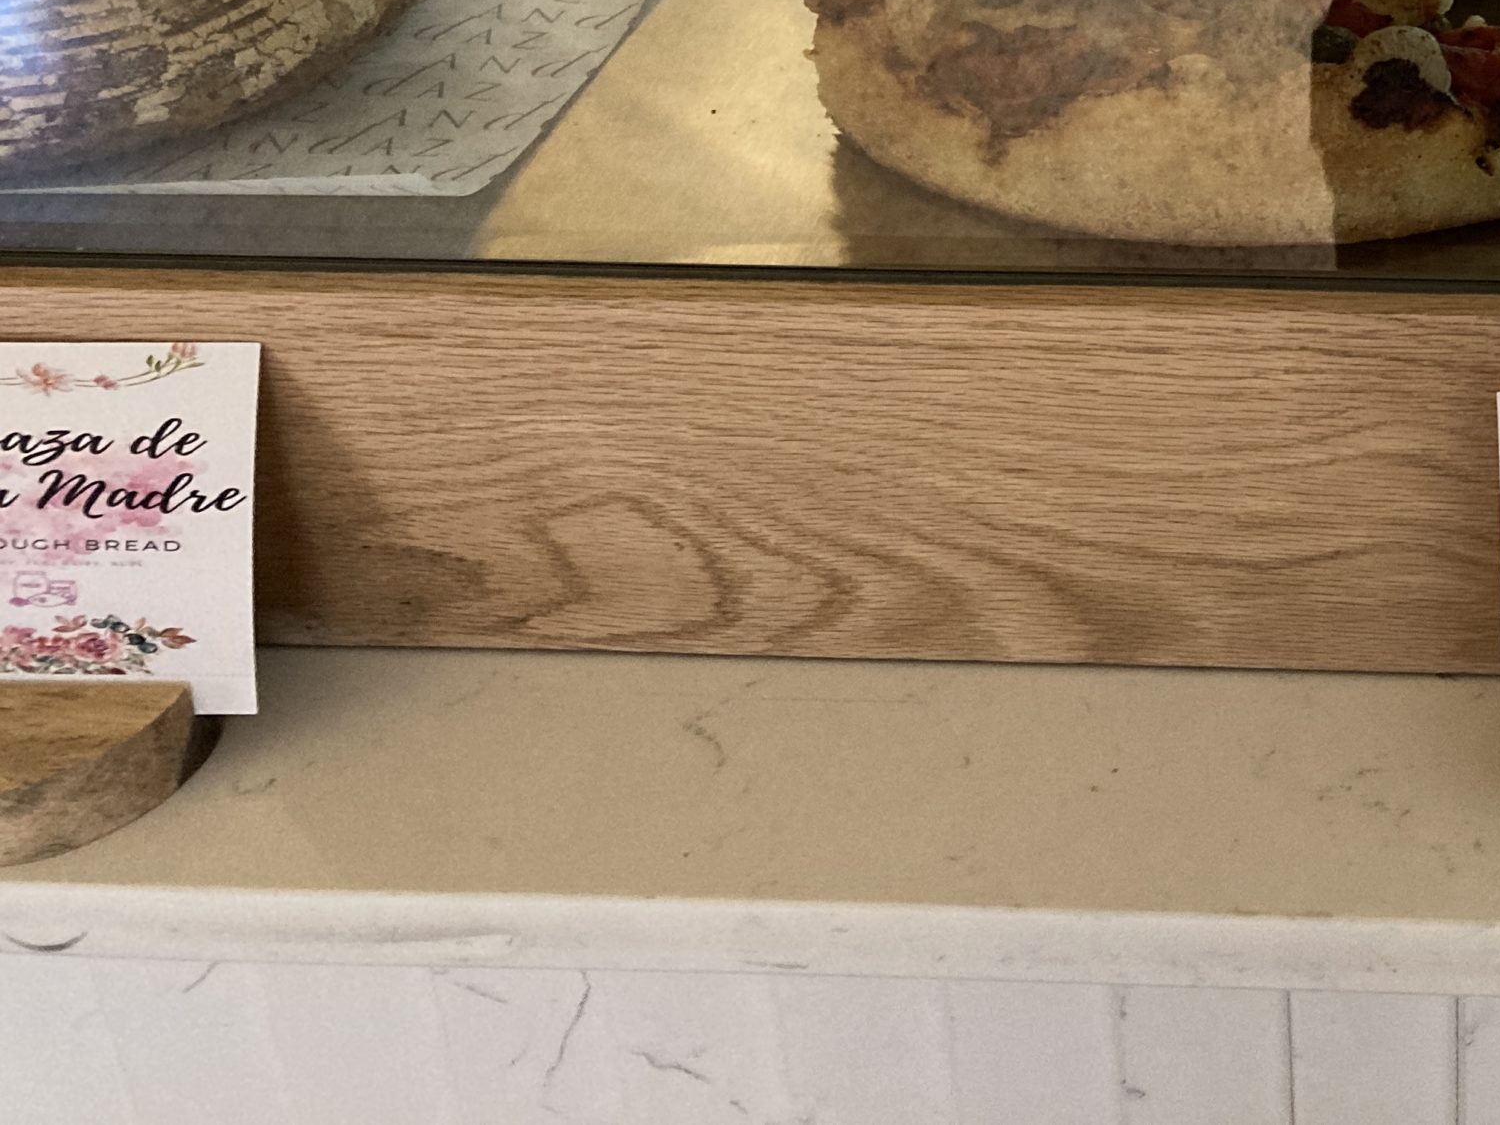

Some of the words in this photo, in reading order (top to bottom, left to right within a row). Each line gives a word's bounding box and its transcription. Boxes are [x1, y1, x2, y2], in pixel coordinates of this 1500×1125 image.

[129, 417, 208, 459] de
[36, 469, 248, 519] Madre
[85, 539, 181, 552] BREAD
